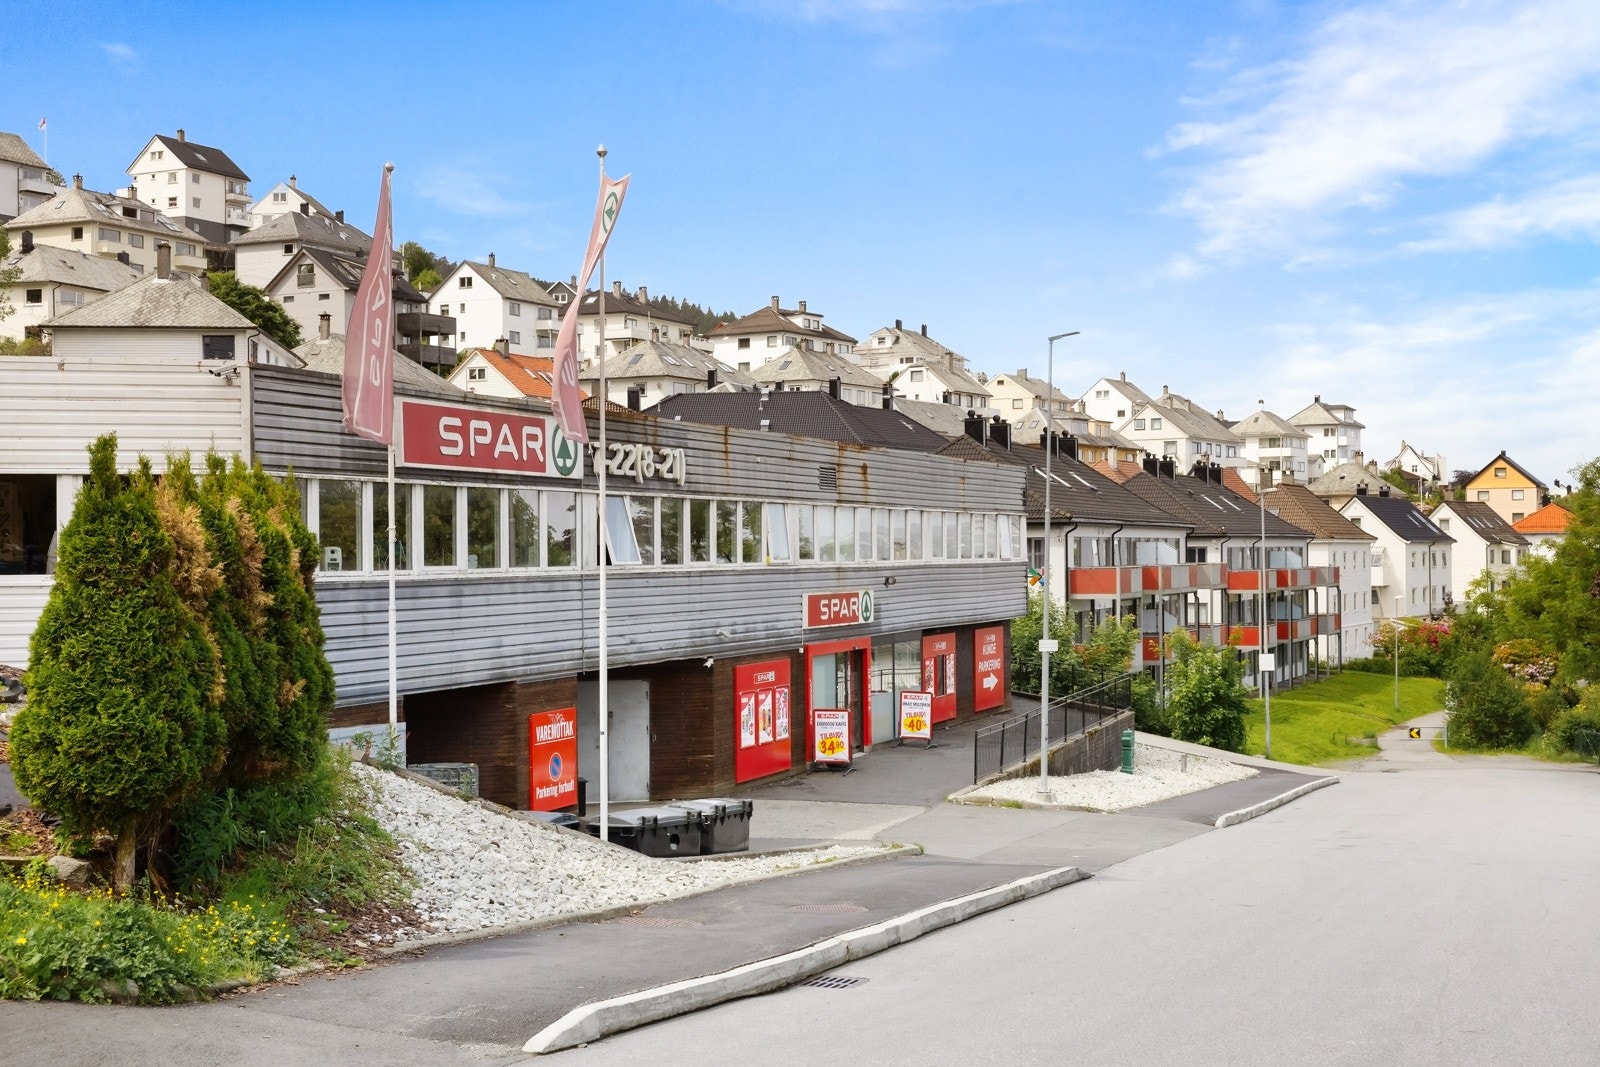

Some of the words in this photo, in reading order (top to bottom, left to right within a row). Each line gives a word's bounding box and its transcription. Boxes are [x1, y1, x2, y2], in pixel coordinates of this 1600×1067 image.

[438, 416, 544, 463] SPAR
[820, 597, 859, 620] SPAR
[982, 643, 997, 655] KUNDE
[978, 658, 1001, 672] PARKERING
[757, 673, 770, 682] SPAR
[535, 720, 574, 743] VAREMOTTAK
[820, 731, 844, 740] TILBUD!
[535, 784, 558, 800] Parkering
[559, 779, 575, 794] forbudt
